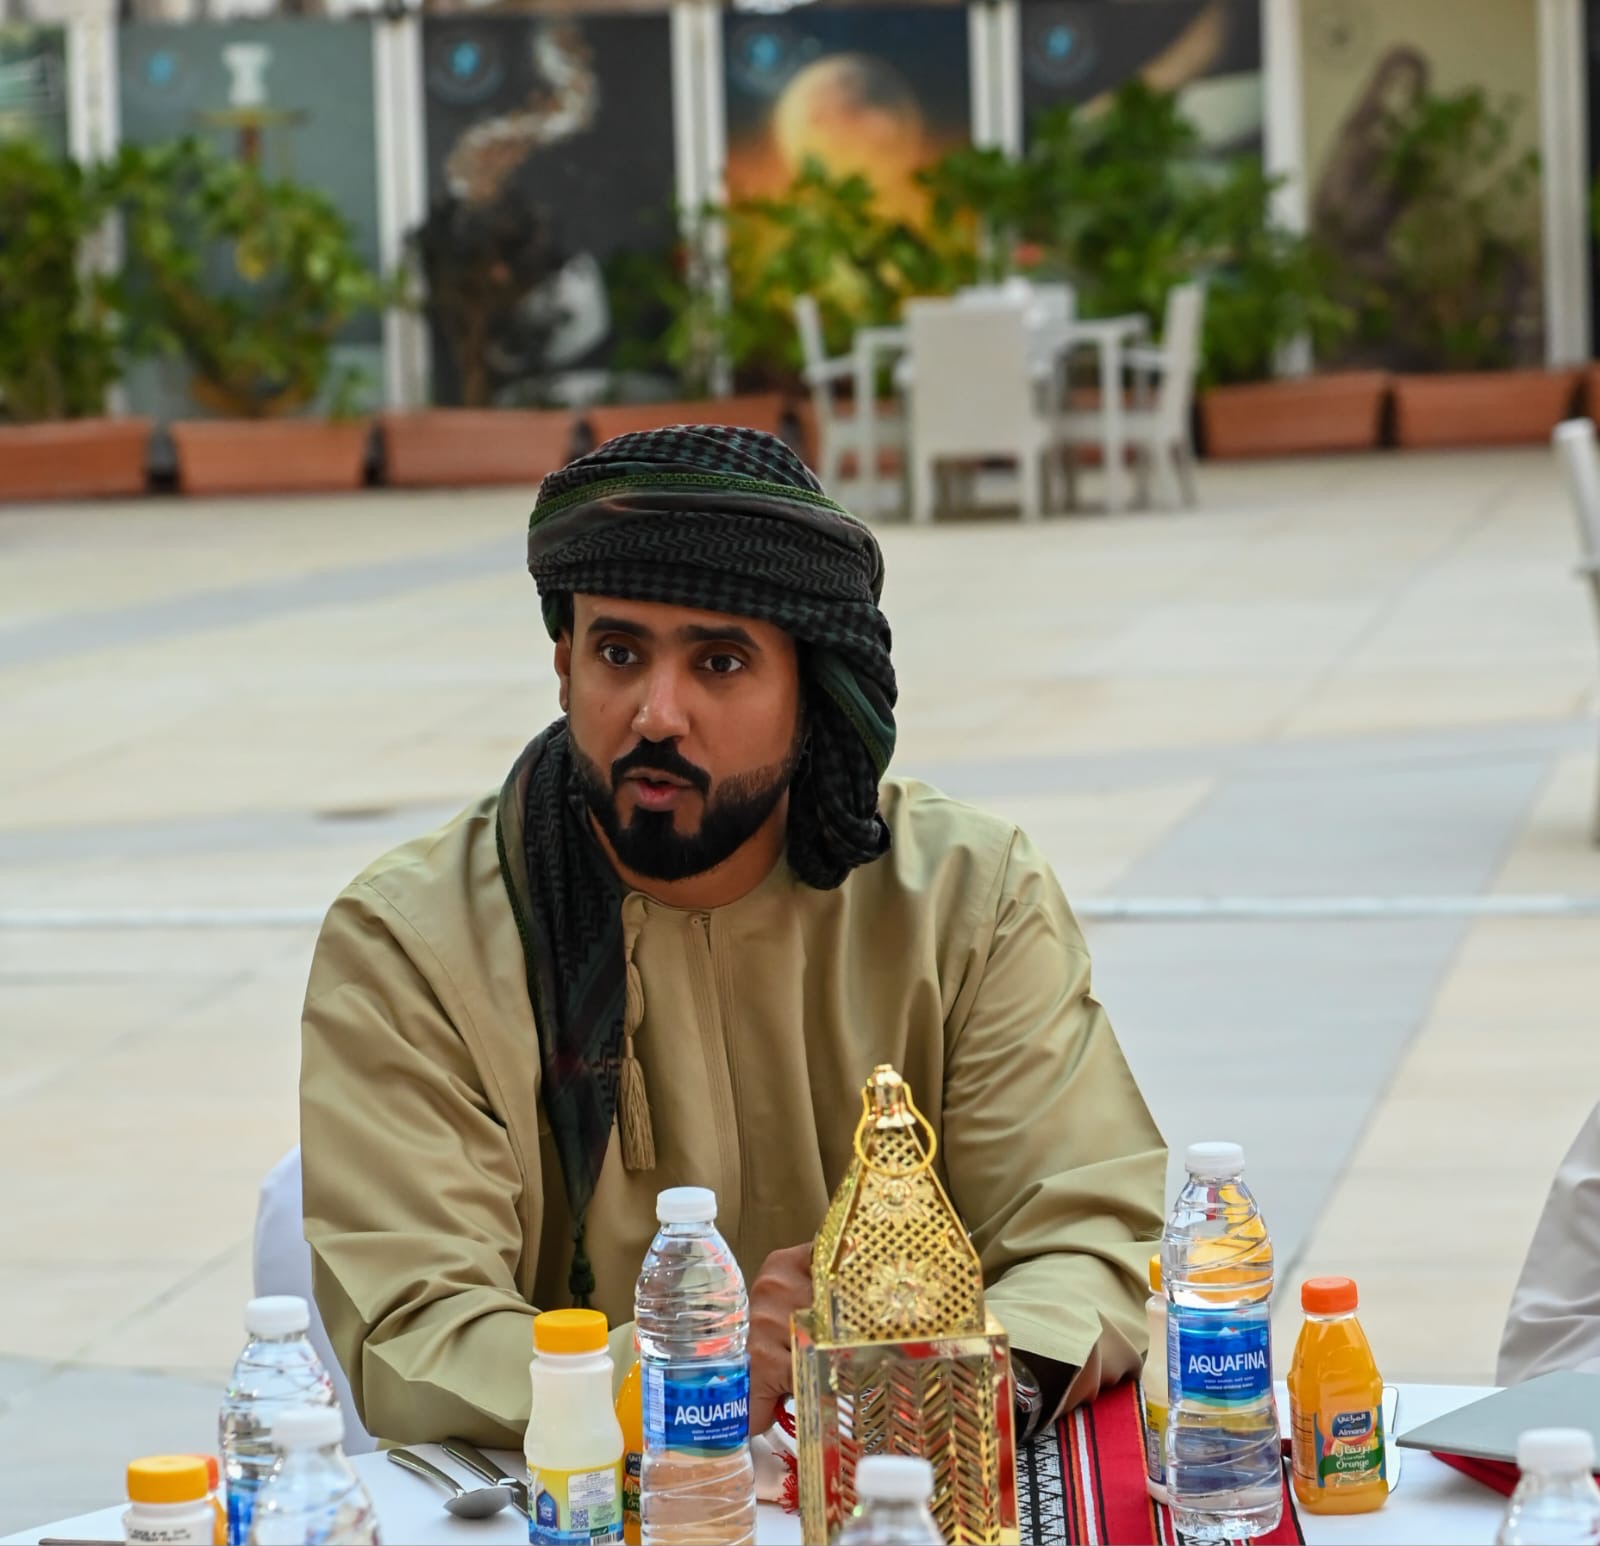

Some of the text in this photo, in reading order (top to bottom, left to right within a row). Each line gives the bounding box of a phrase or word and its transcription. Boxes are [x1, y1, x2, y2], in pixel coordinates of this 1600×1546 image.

[1188, 1350, 1266, 1376] AQUAFINA
[674, 1397, 748, 1426] AQUAFINA
[1335, 1458, 1370, 1471] Orange
